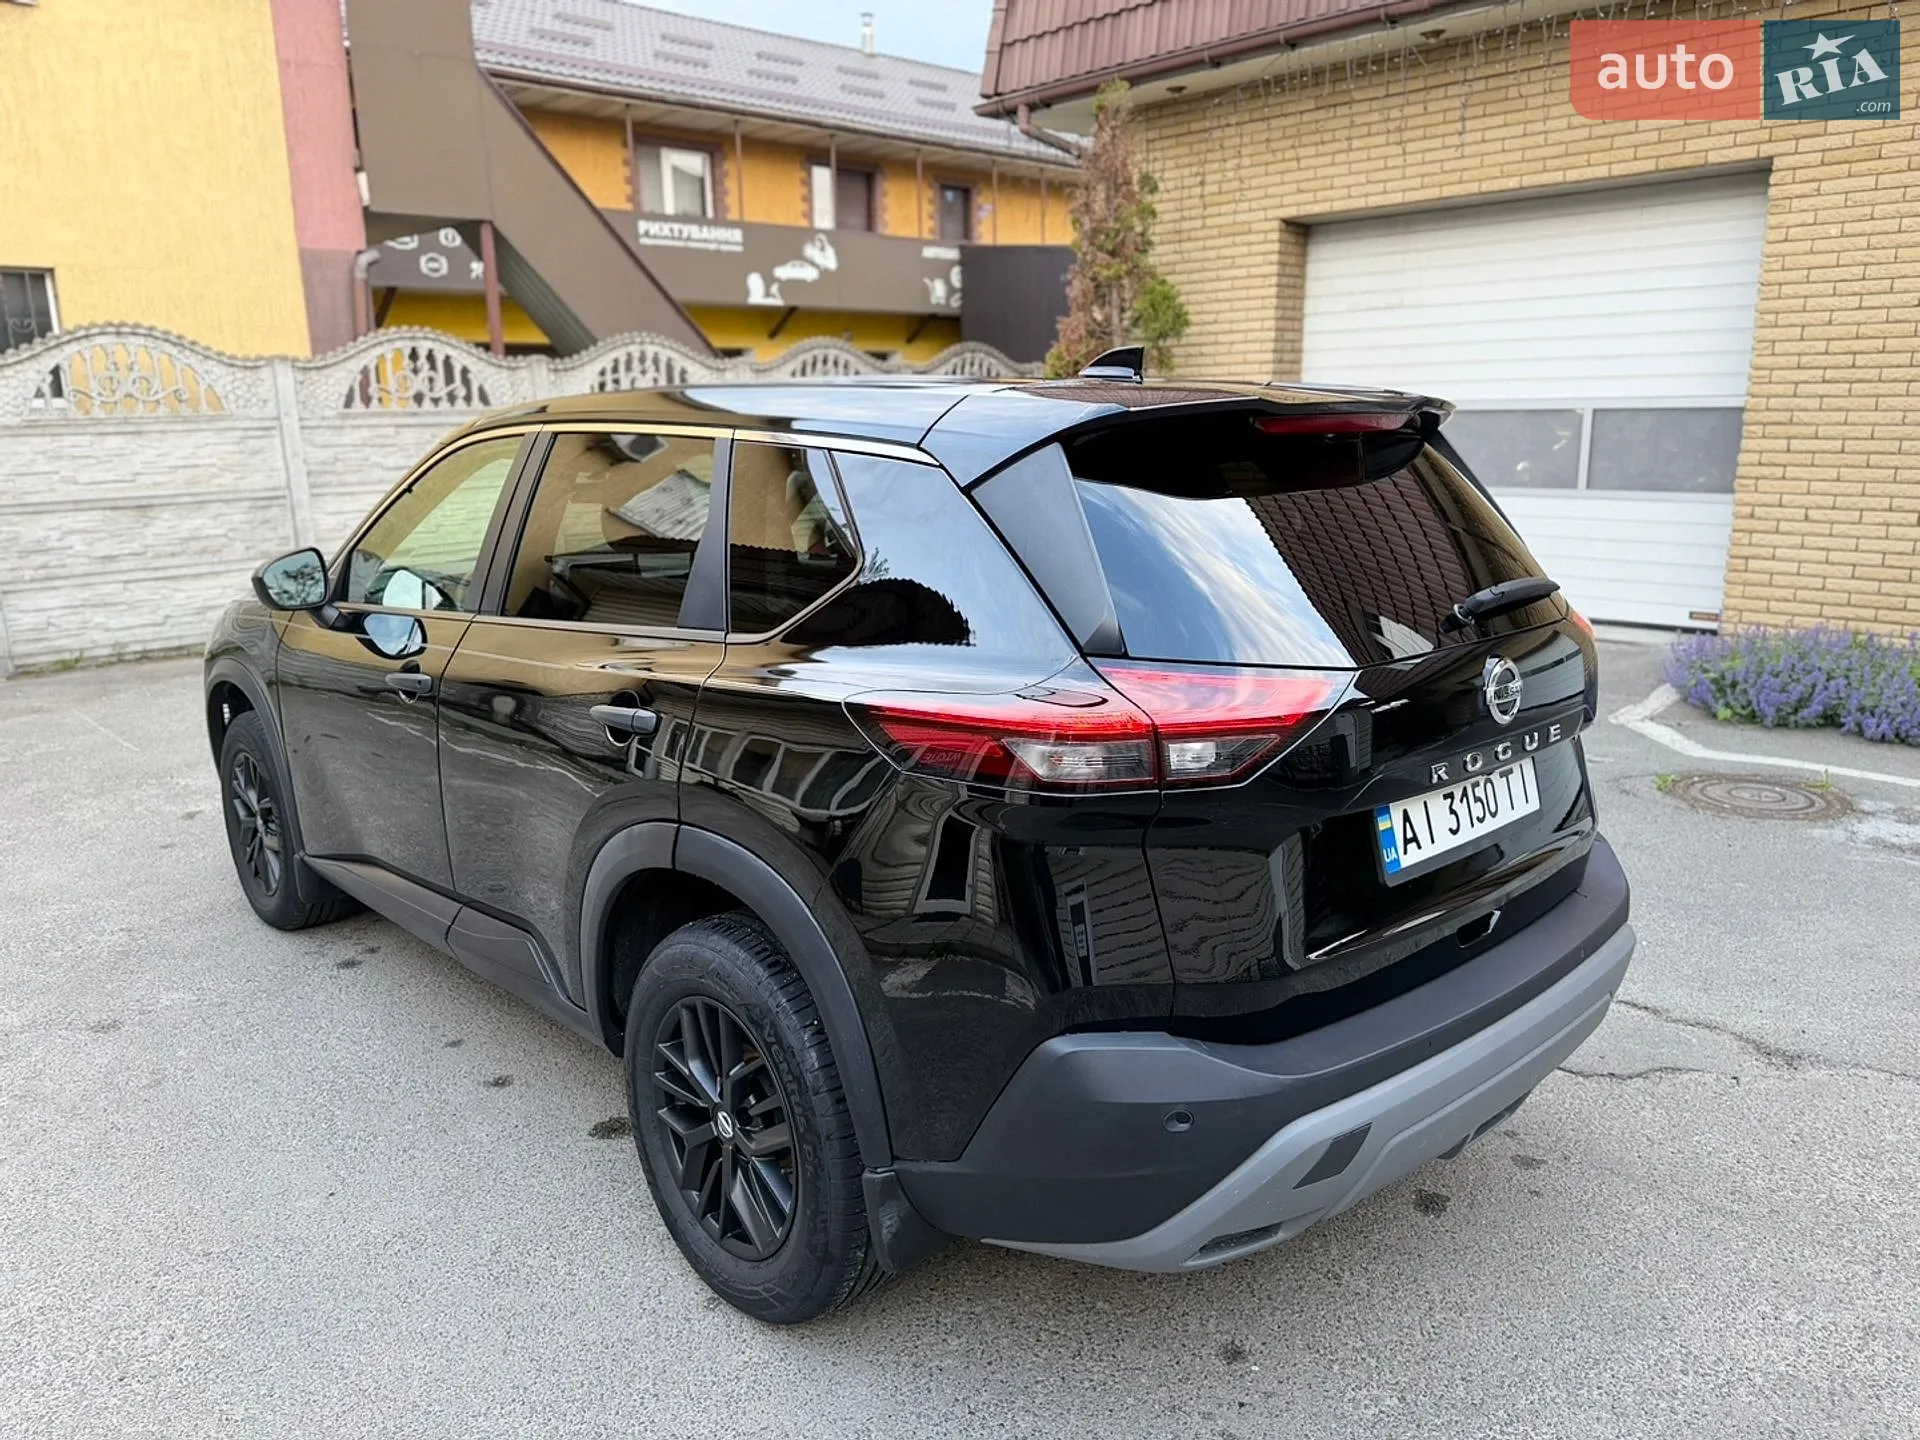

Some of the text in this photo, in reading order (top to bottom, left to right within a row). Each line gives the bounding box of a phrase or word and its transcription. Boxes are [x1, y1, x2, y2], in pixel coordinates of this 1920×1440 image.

[637, 219, 743, 243] РИХТУВАННЯ
[1430, 724, 1562, 784] ROGUE
[1403, 763, 1530, 856] AI 3150 TI
[1383, 848, 1400, 863] UA
